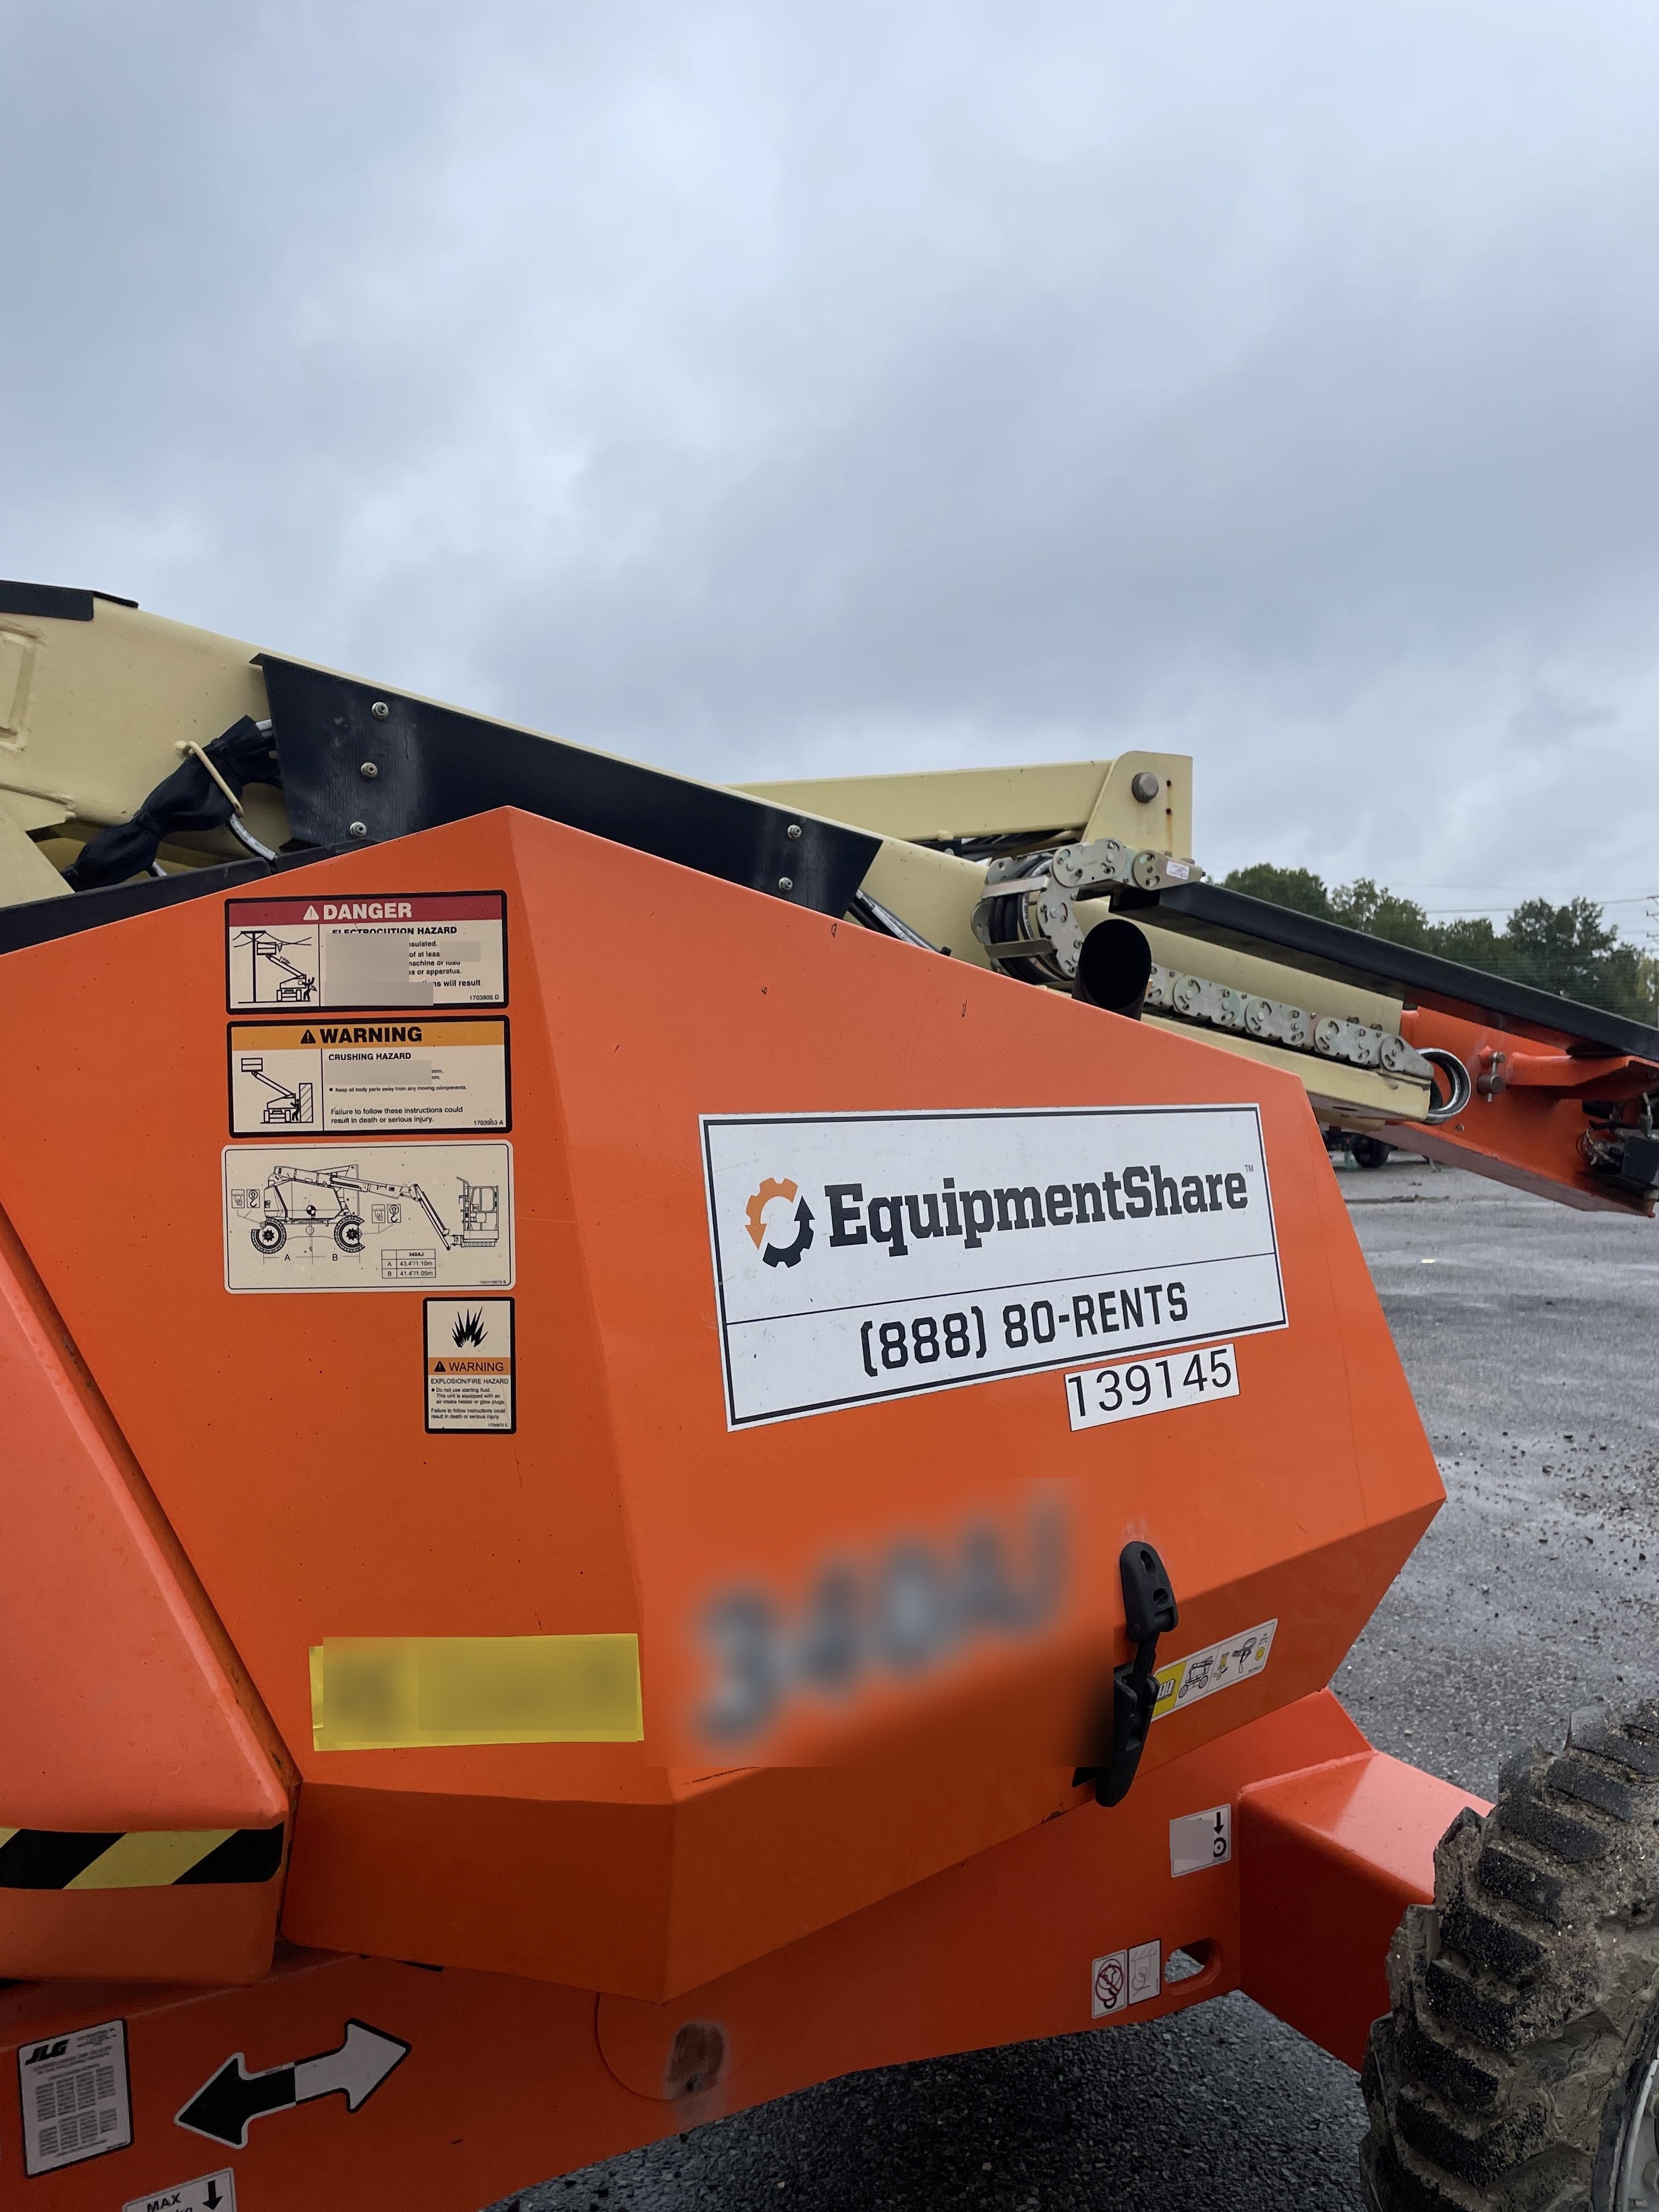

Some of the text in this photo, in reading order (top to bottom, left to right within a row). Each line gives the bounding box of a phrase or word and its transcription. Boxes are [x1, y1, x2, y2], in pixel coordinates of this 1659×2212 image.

[323, 902, 412, 920] DANGER
[417, 927, 457, 935] HAZARD
[319, 1026, 422, 1043] WARNING
[825, 1165, 1249, 1257] EquipmentShare
[861, 1282, 1188, 1376] (888) 80-RENTS
[449, 1362, 504, 1372] WARNING
[1068, 1348, 1232, 1418] 139145
[24, 2039, 70, 2066] JLG
[147, 2192, 181, 2212] MAX
